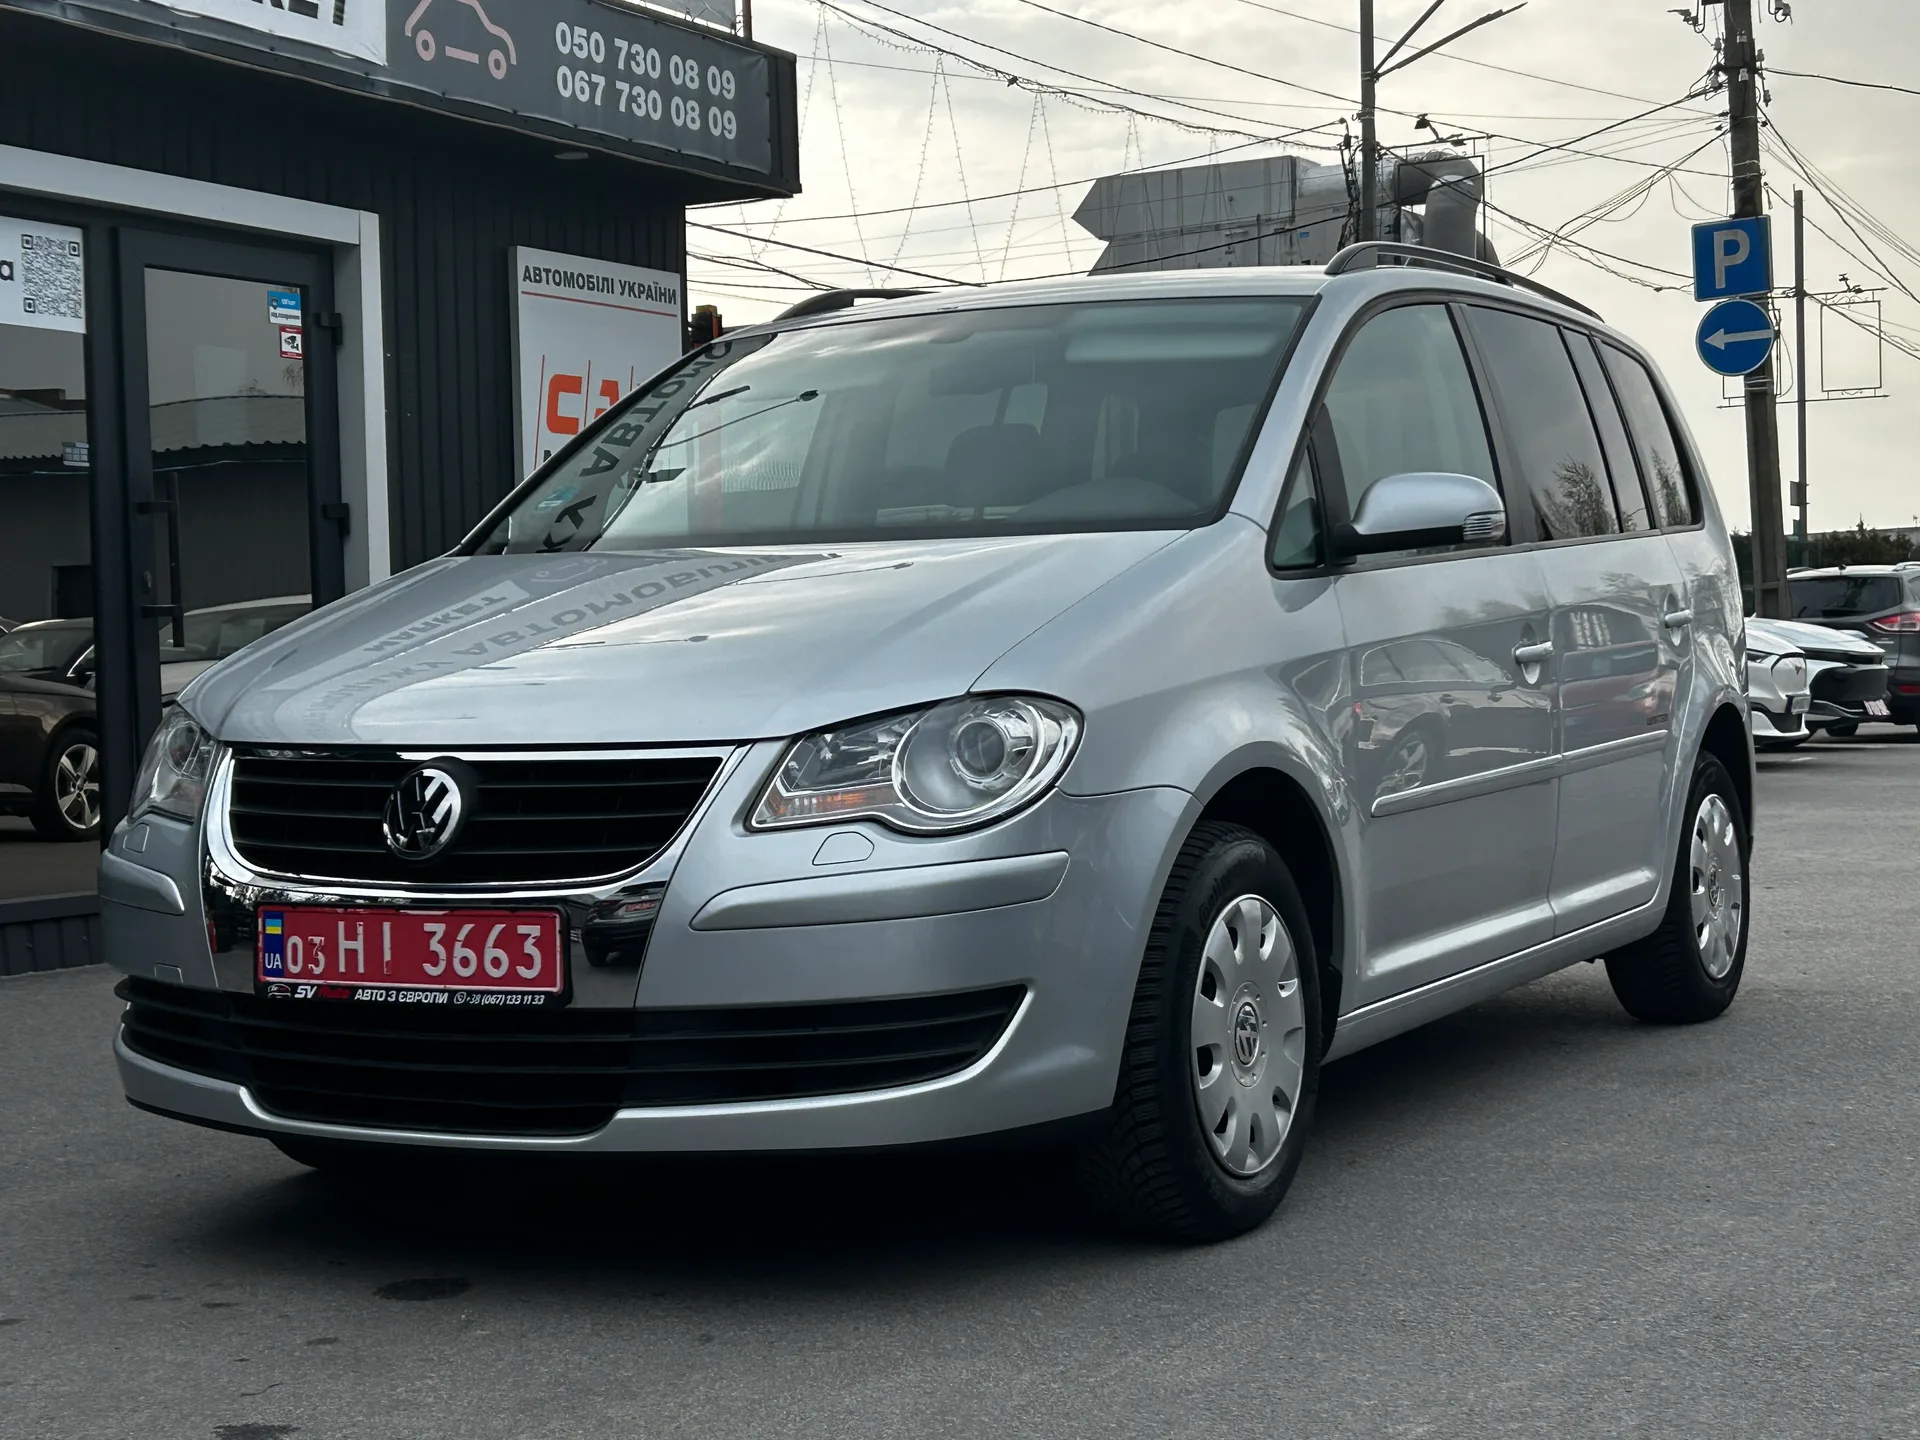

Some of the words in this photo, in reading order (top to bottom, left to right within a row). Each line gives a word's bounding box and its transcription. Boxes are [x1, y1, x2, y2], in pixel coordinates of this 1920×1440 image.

[556, 21, 605, 64] 050
[614, 37, 661, 79] 730
[669, 54, 700, 90] 08
[707, 65, 736, 100] 09
[557, 65, 606, 106] 067
[615, 80, 662, 121] 730
[670, 96, 701, 131] 08
[708, 106, 737, 140] 09
[1713, 228, 1750, 289] P
[522, 265, 615, 295] АВТОМОБІЛІ
[618, 279, 677, 305] УКРАЇНИ
[265, 953, 283, 969] UA
[286, 935, 326, 975] 03
[422, 922, 542, 980] 3663
[294, 985, 317, 998] SV
[354, 989, 386, 1001] АВТО
[398, 991, 448, 1003] ЄВРОПИ
[506, 995, 522, 1004] 133
